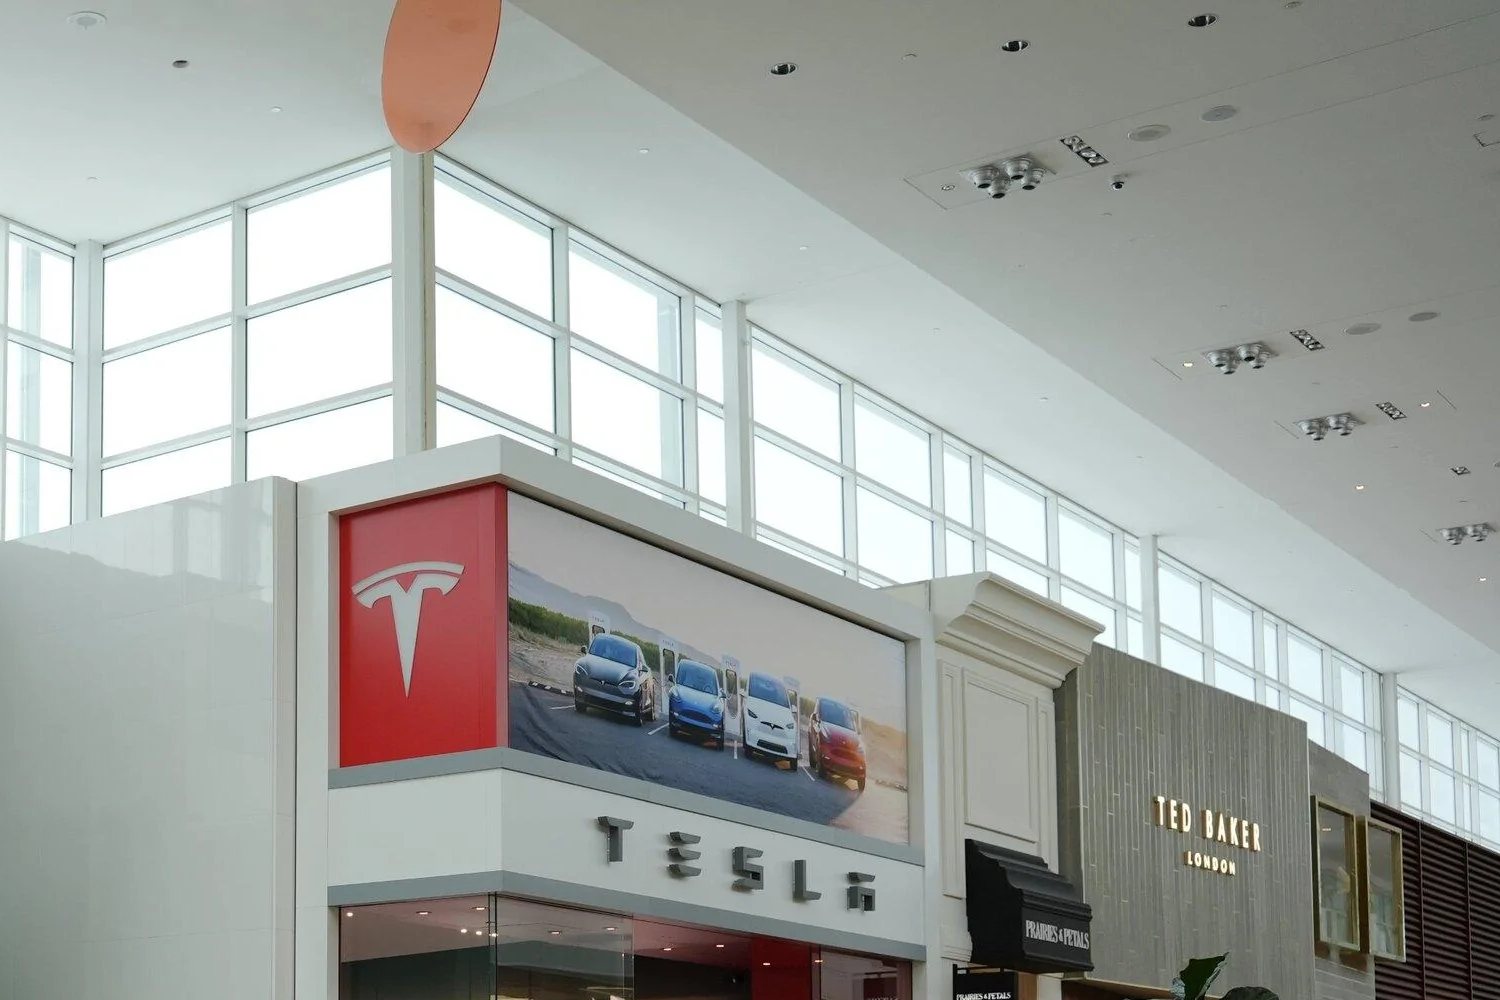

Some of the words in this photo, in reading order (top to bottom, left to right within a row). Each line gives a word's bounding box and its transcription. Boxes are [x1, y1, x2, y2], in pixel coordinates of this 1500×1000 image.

[1155, 795, 1191, 832] TED
[1202, 809, 1260, 851] BAKER
[597, 815, 876, 911] TESLA
[1185, 850, 1236, 875] LONDON
[1025, 919, 1058, 943] PRAIRIES
[1063, 930, 1090, 950] PETALS
